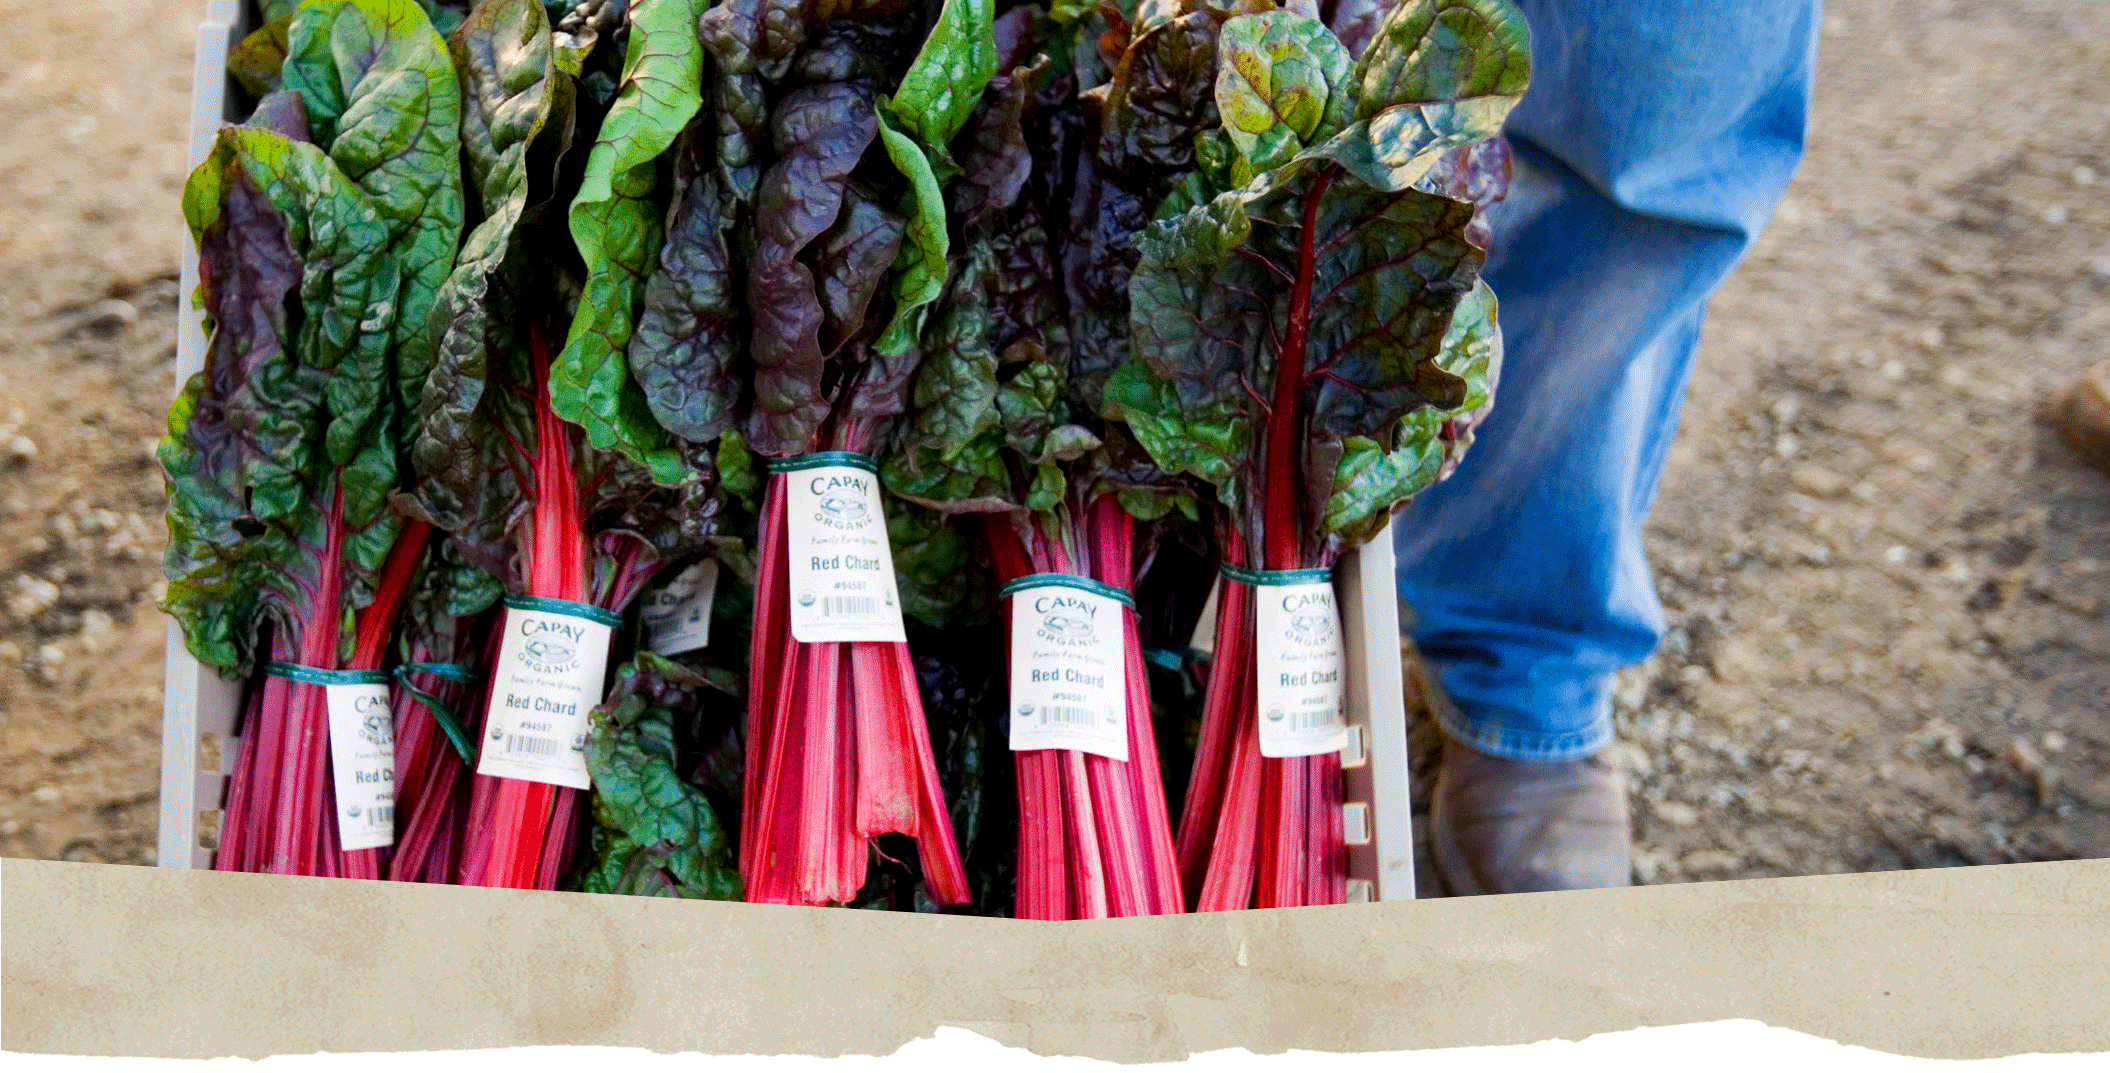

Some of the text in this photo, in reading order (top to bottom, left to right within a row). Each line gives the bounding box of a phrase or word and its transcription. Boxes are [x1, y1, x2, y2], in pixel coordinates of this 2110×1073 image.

[811, 476, 868, 496] CAPAY
[814, 512, 872, 530] ORGANIC
[811, 536, 838, 545] Family
[811, 555, 881, 571] Red Chard
[834, 581, 866, 590] #94587
[1035, 597, 1098, 619] CAPAY
[1282, 593, 1333, 613] CAPAY
[521, 618, 585, 644] CAPAY
[1037, 629, 1100, 647] ORGANIC
[1285, 628, 1335, 647] ORGANIC
[518, 653, 580, 674] ORGANIC
[1032, 651, 1059, 659] Family
[511, 674, 534, 686] Family
[1032, 668, 1104, 689] Red Chard
[1280, 668, 1338, 687] Red Chard
[506, 694, 577, 716] Red Chard
[355, 770, 379, 784] Red
